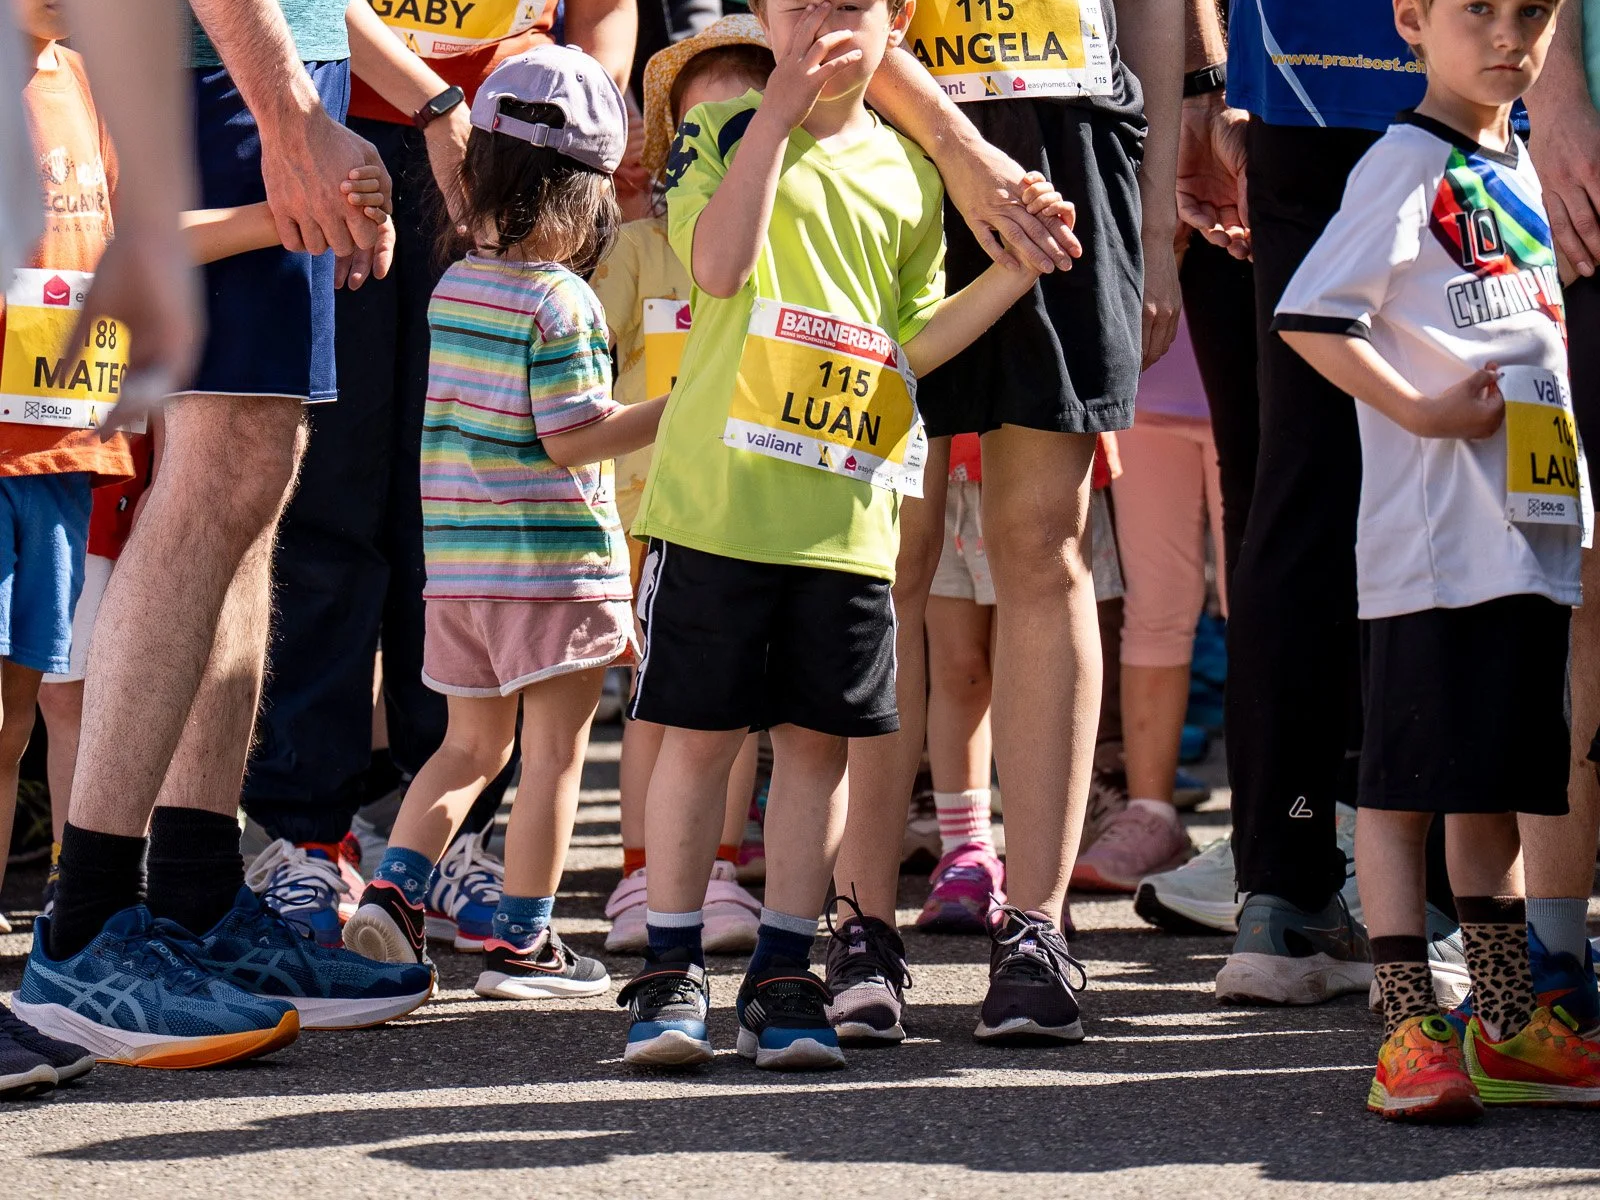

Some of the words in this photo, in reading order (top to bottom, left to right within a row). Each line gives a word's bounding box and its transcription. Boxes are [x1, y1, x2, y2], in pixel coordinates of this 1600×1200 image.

[913, 31, 1068, 68] ANGELA
[1271, 54, 1427, 74] www.praxisost.ch
[1027, 79, 1076, 91] easyhomes.ch
[1094, 76, 1107, 85] 115
[1455, 207, 1506, 267] 10
[1447, 264, 1563, 329] CHAMPIO
[781, 311, 891, 357] BÄRNERBÄR
[819, 360, 871, 398] 115
[780, 391, 881, 446] LUAN
[746, 431, 803, 457] valiant
[1530, 451, 1579, 490] LAU
